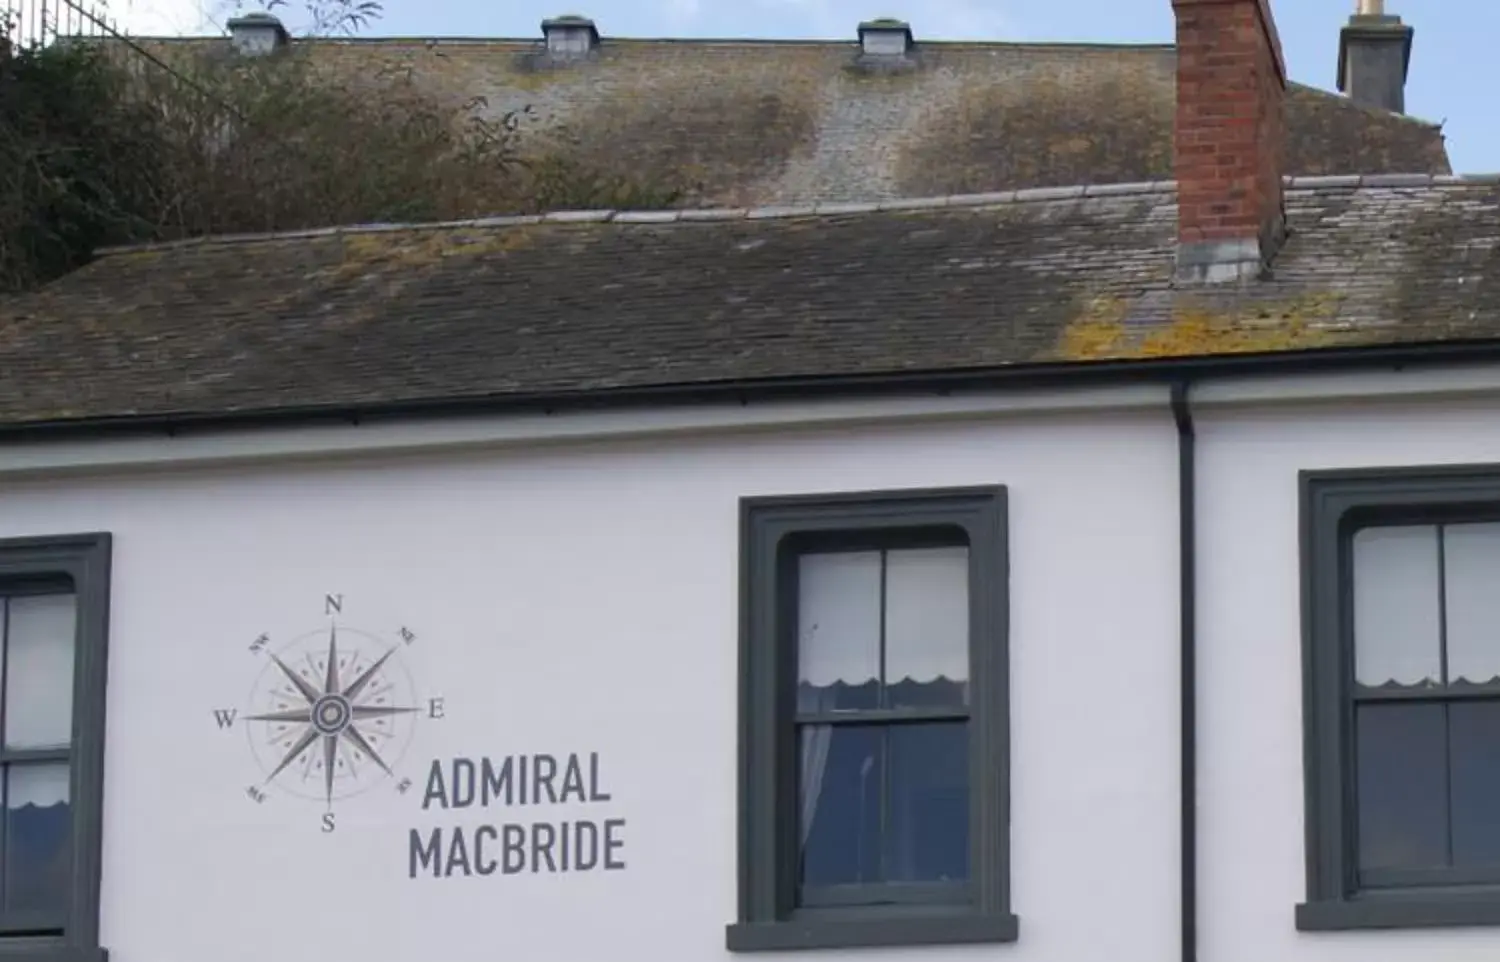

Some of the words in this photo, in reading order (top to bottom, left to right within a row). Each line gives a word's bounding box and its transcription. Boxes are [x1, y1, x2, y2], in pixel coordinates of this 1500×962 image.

[324, 594, 343, 614] N
[428, 699, 445, 718] E
[213, 709, 238, 729] W
[421, 752, 612, 810] ADMIRAL
[321, 813, 336, 833] S
[408, 818, 627, 879] MACBRIDE
